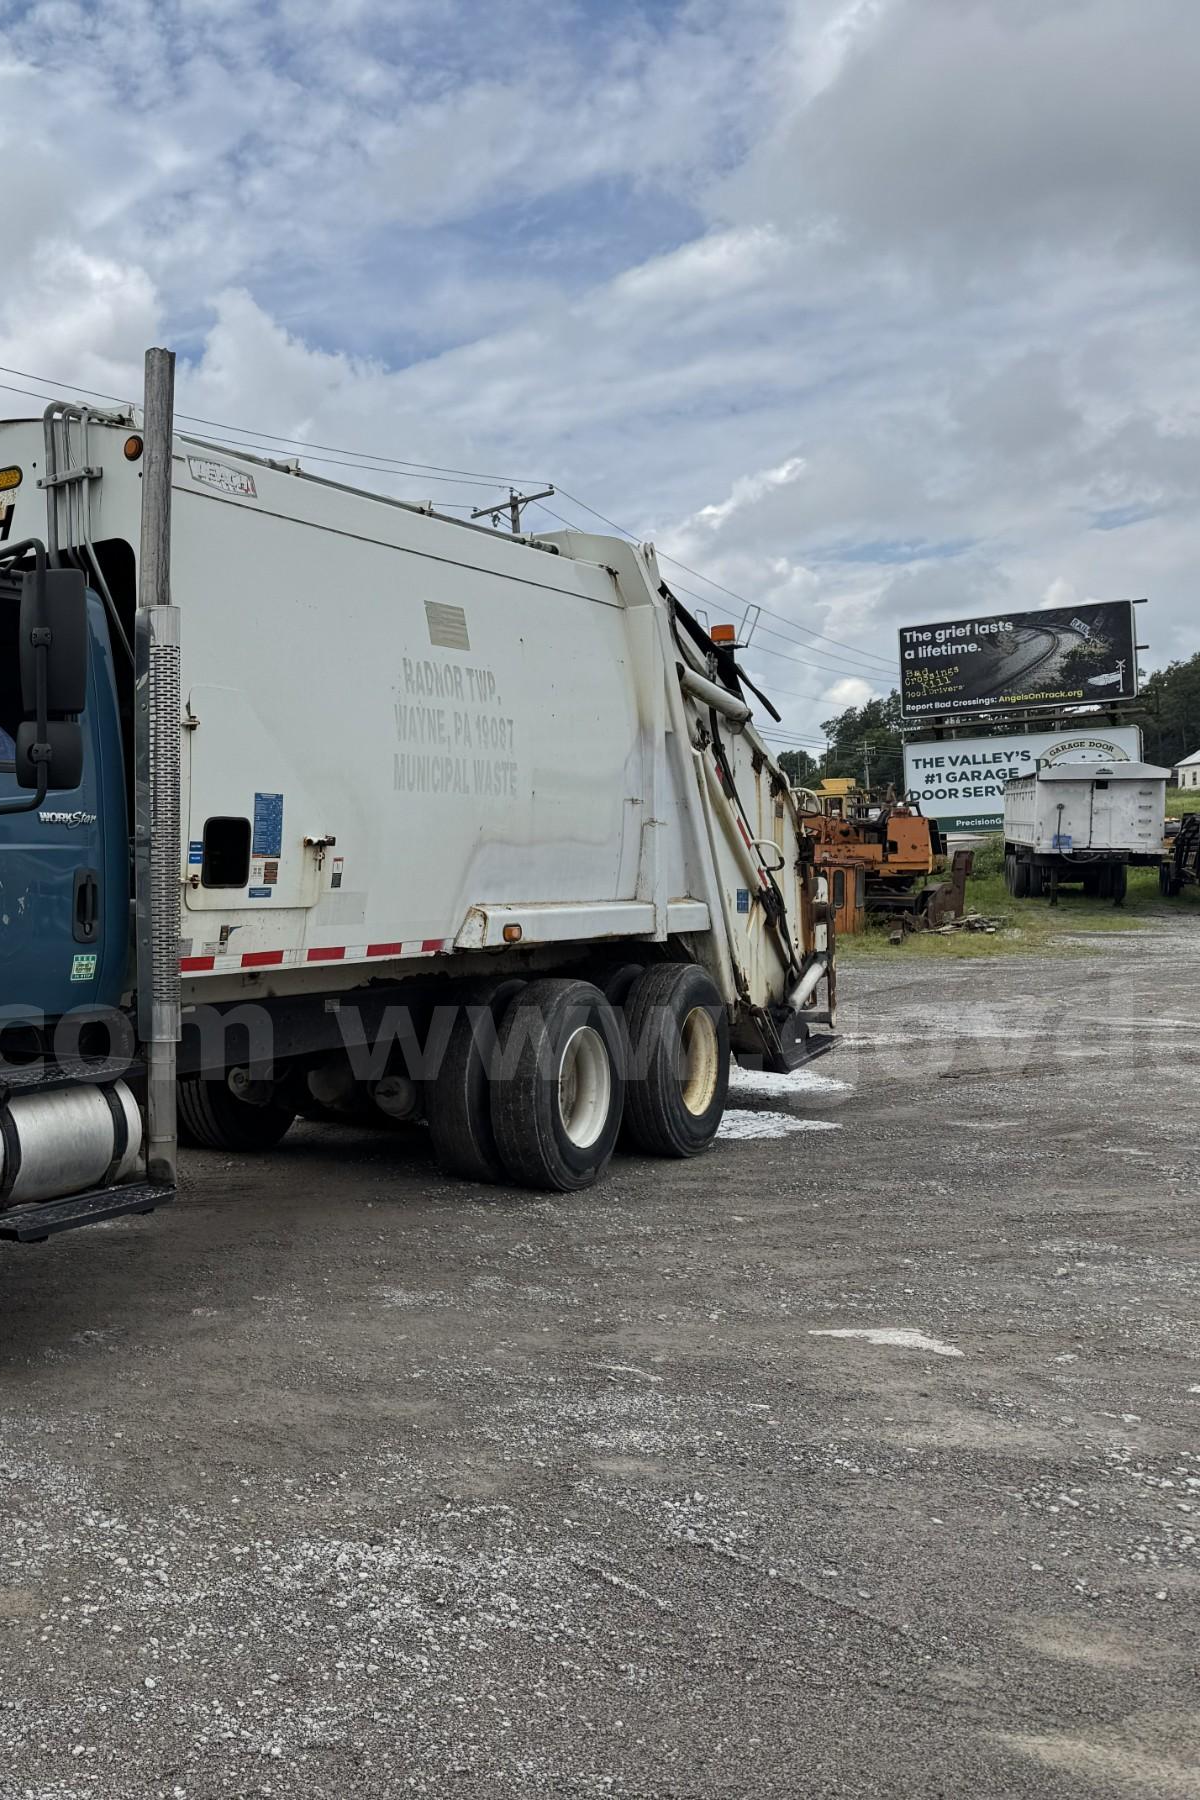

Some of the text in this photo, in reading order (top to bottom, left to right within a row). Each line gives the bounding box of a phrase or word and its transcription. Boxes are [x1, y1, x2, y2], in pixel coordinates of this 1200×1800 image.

[904, 621, 1013, 643] The grief lasts
[905, 643, 982, 659] a lifetime.
[402, 657, 464, 702] RADNOR
[905, 668, 928, 677] Bad
[905, 666, 959, 686] Crossings
[921, 676, 951, 691] Kill
[906, 690, 1083, 712] Report Bad Crossings: AngelsOnTrack.org
[394, 704, 452, 753] WAYNE,
[454, 711, 472, 748] PA
[1049, 742, 1114, 756] GARAGE DOOR
[912, 757, 945, 769] THE
[948, 750, 1031, 767] VALLEY'S
[393, 753, 518, 796] MUNICIPAL WASTE
[925, 768, 1019, 784] #1 GARAGE
[910, 788, 959, 801] DOOR
